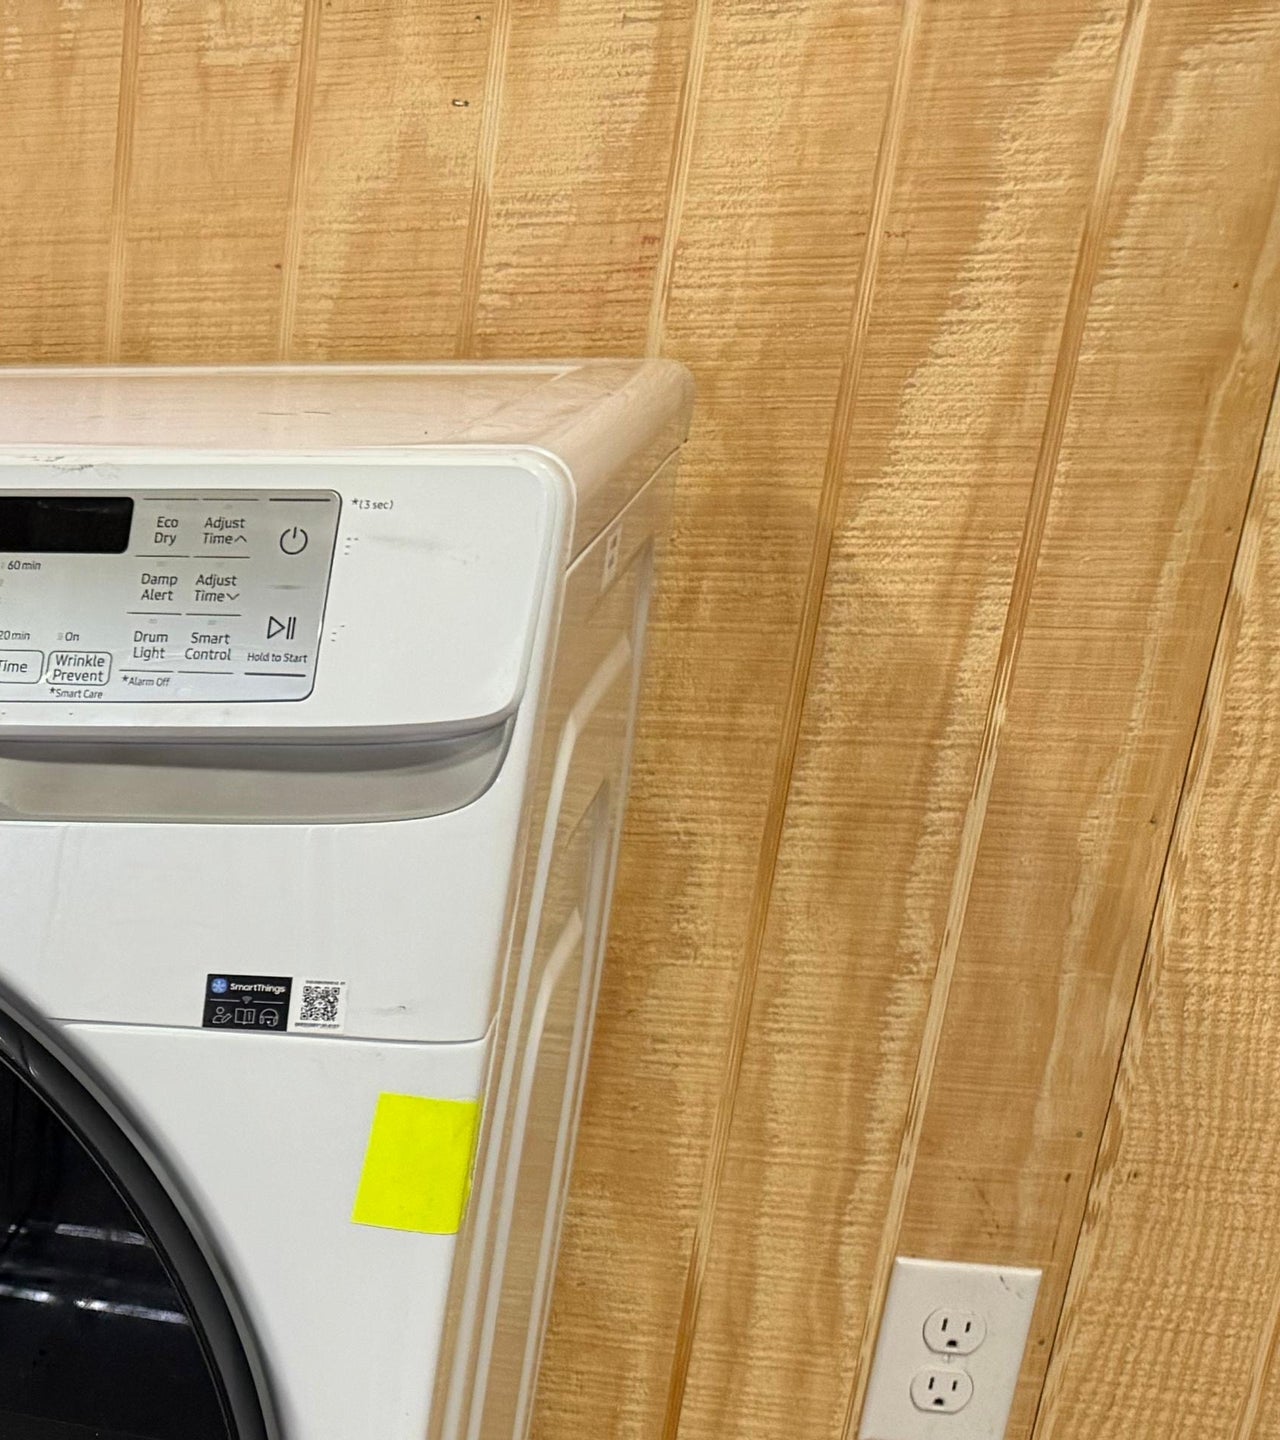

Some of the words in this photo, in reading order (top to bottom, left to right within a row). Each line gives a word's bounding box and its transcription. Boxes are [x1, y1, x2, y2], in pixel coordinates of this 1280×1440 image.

[372, 499, 393, 510] sec)
[156, 516, 179, 529] Eco
[204, 516, 246, 530] Adjust
[154, 532, 177, 547] Dry
[203, 533, 233, 545] Time
[141, 573, 178, 587] Damp
[196, 573, 237, 588] Adjust
[141, 588, 173, 602] Alert
[195, 589, 225, 602] Time
[64, 632, 80, 642] On
[133, 630, 168, 643] Drum
[190, 632, 230, 645] Smart
[133, 647, 165, 661] Light
[184, 648, 231, 661] Control
[247, 652, 270, 663] Hold
[271, 653, 281, 663] to
[283, 653, 308, 664] Start
[55, 654, 105, 668] Wrinkle
[52, 669, 104, 683] Prevent
[156, 677, 170, 687] Off
[83, 690, 103, 700] Care
[230, 982, 286, 995] SmartThings
